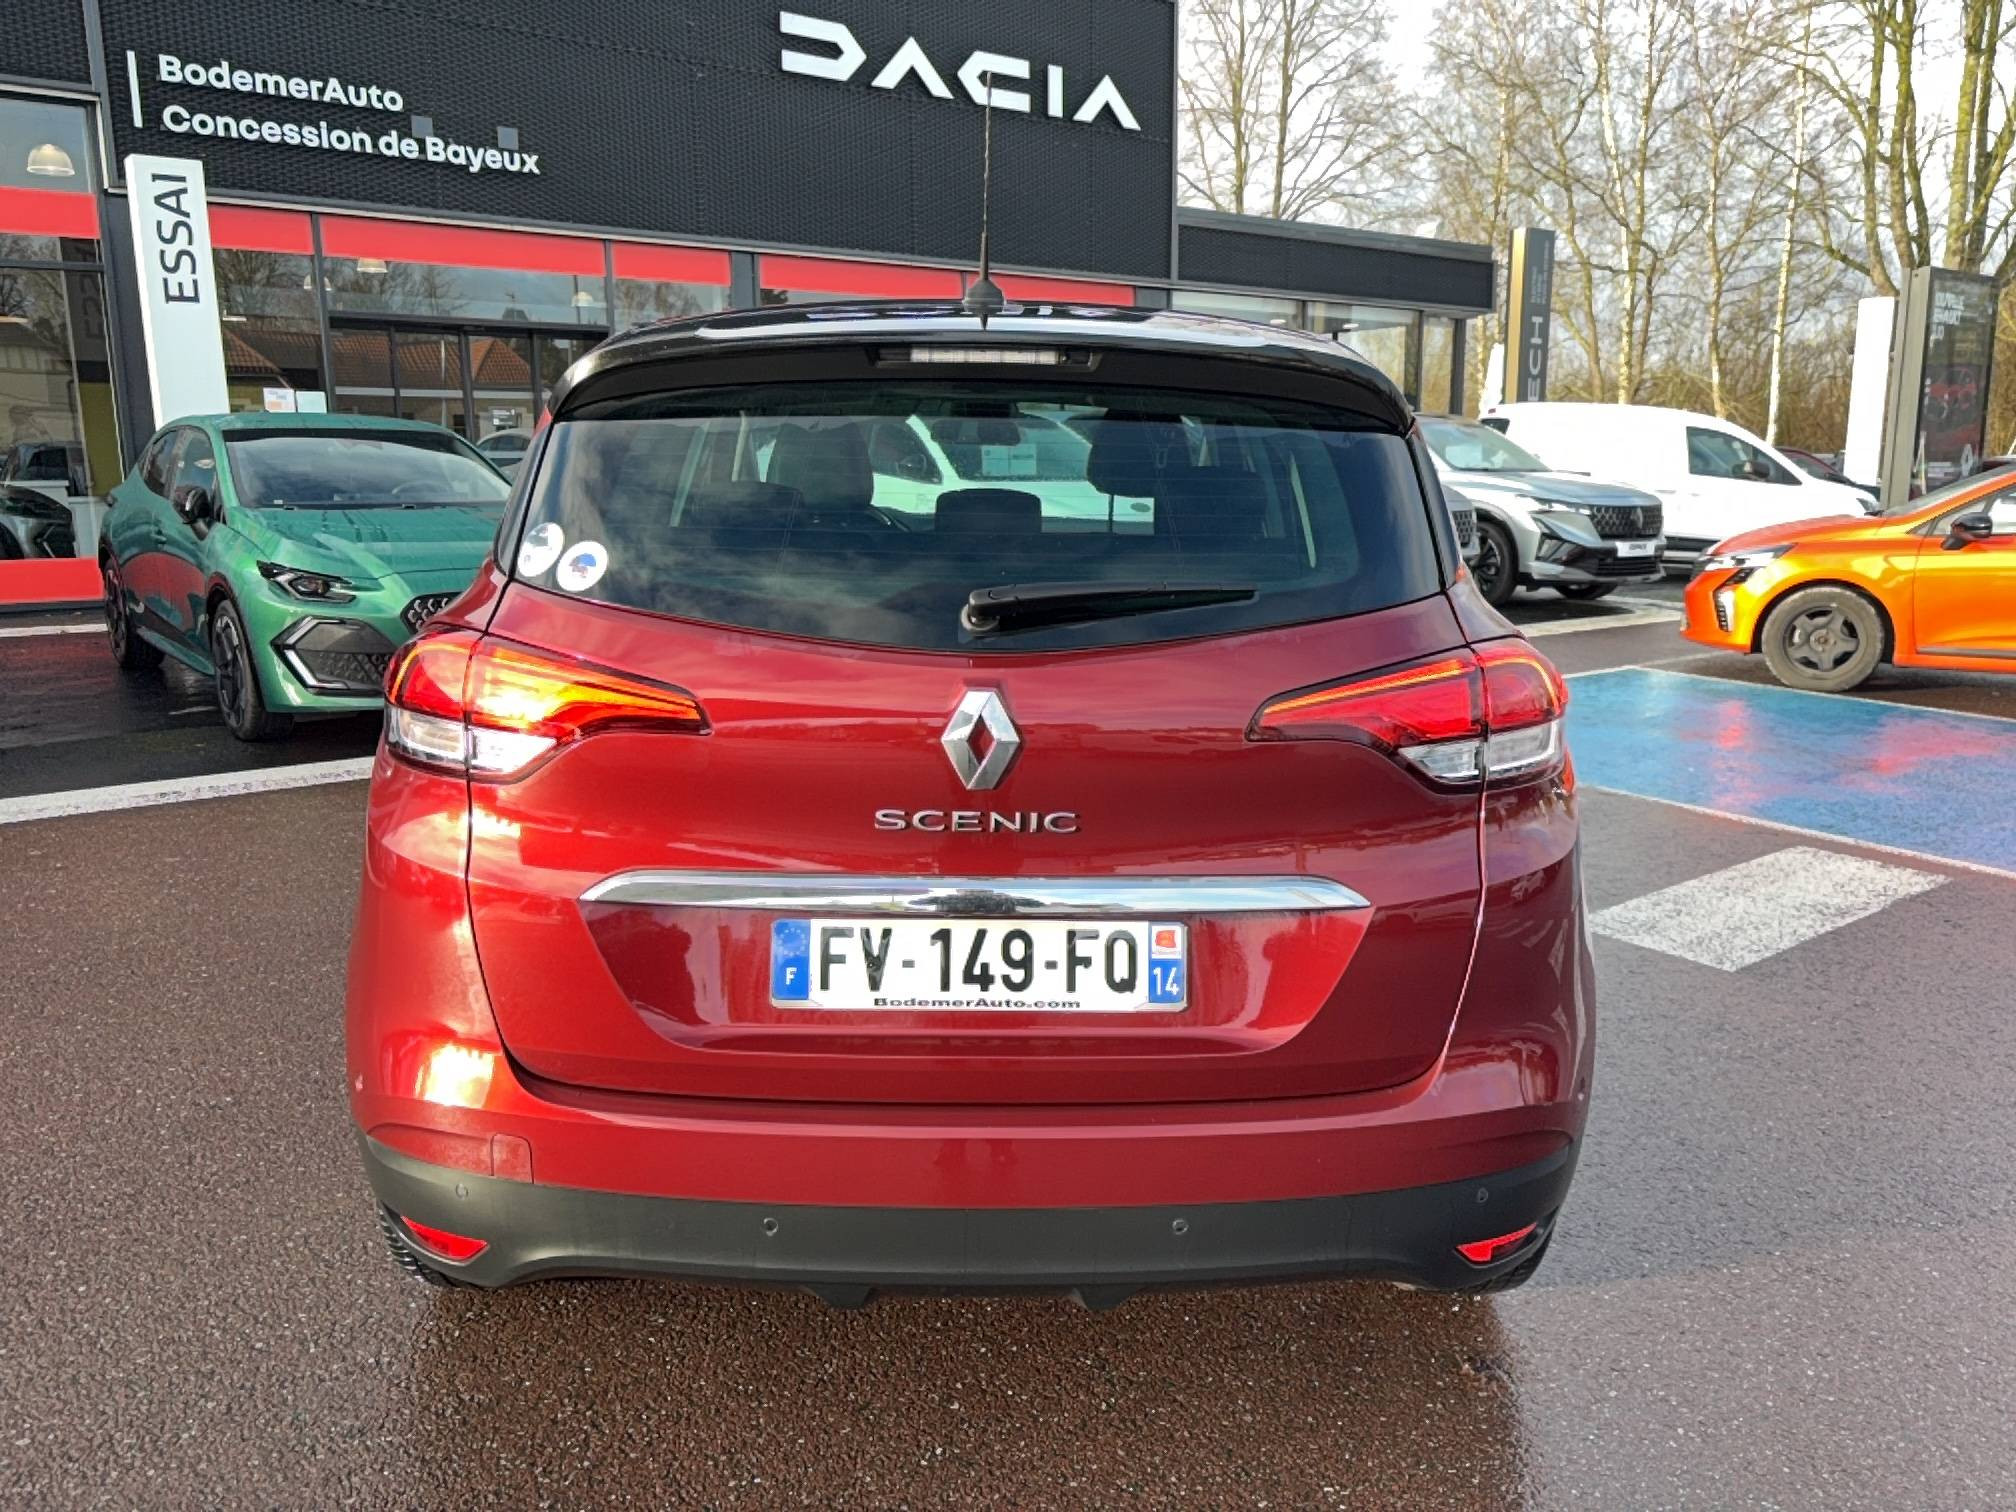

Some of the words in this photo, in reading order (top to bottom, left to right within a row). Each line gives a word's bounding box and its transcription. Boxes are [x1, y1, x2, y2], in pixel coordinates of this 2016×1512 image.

[158, 53, 404, 112] BodemerAuto
[779, 10, 1141, 131] DACIA
[163, 105, 374, 155] Concession
[379, 129, 420, 158] de
[425, 136, 541, 175] Bayeux
[151, 172, 201, 305] ESSAI
[873, 808, 1079, 833] SCENIC
[785, 967, 797, 986] F
[820, 926, 1139, 994] FV-149-FQ
[1153, 966, 1179, 996] 14
[873, 997, 1081, 1009] BodemerAuto.com
